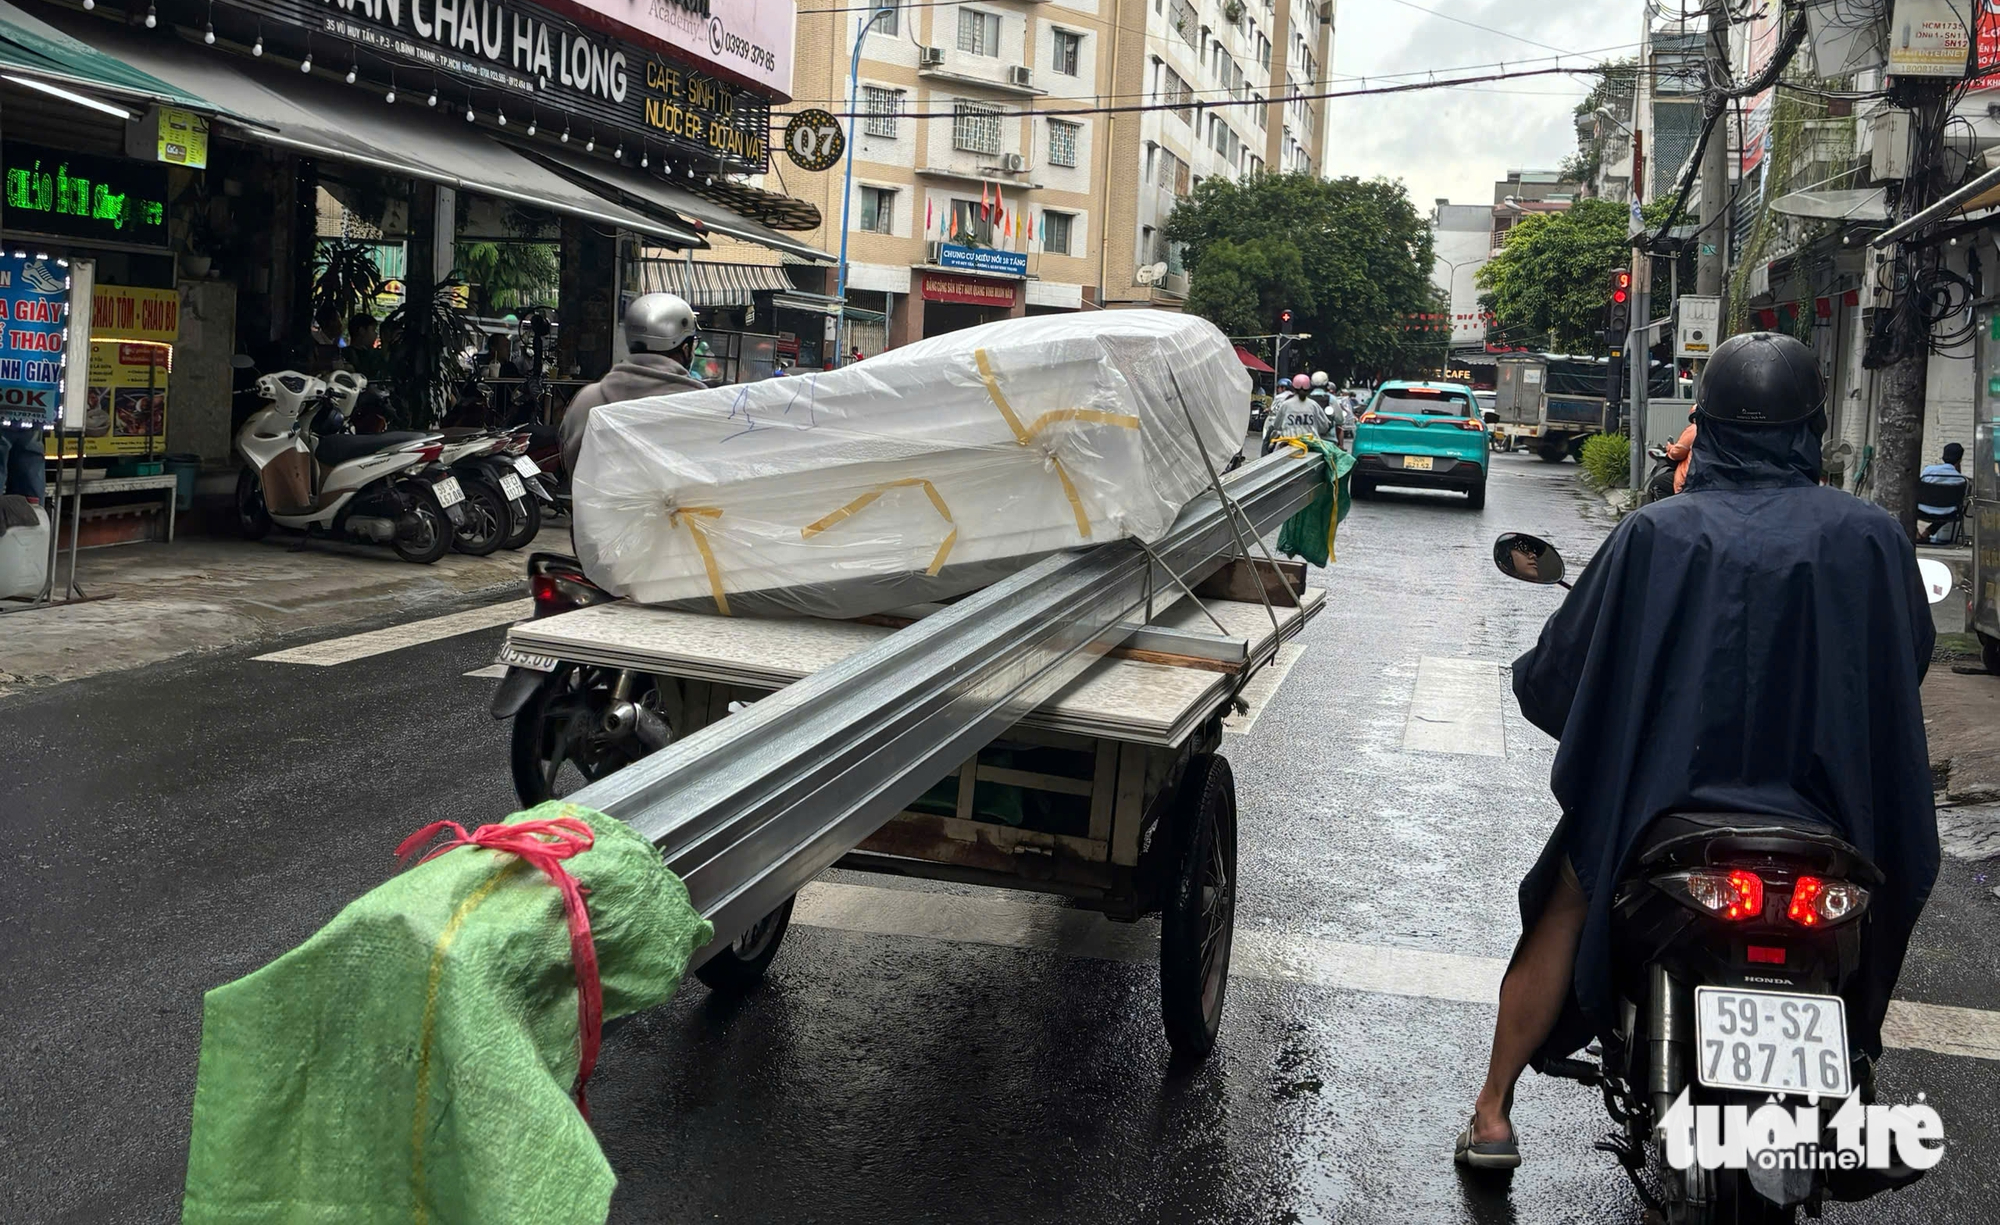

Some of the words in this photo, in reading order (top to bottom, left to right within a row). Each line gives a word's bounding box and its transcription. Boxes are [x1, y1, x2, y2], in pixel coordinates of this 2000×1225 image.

[347, 25, 361, 39] HUY
[1922, 22, 1964, 30] HCM1735
[724, 32, 750, 60] 03939
[750, 44, 766, 69] 379
[764, 55, 776, 73] 85
[1919, 49, 1966, 58] INTERNET
[1944, 40, 1968, 48] SN12
[513, 12, 551, 90] HẠ
[560, 31, 627, 103] LONG
[647, 61, 680, 97] CAFE
[645, 98, 683, 134] NƯỚC
[792, 125, 837, 162] Q7
[943, 250, 966, 259] CHUNG
[1620, 275, 1628, 288] 9
[15, 298, 63, 323] GIÀY
[9, 330, 62, 353] THAO
[25, 357, 60, 383] GIÀY
[1446, 370, 1471, 379] CAFE
[1744, 975, 1794, 986] HONDA
[1717, 996, 1823, 1043] 59-S2
[1706, 1039, 1840, 1090] 787.16
